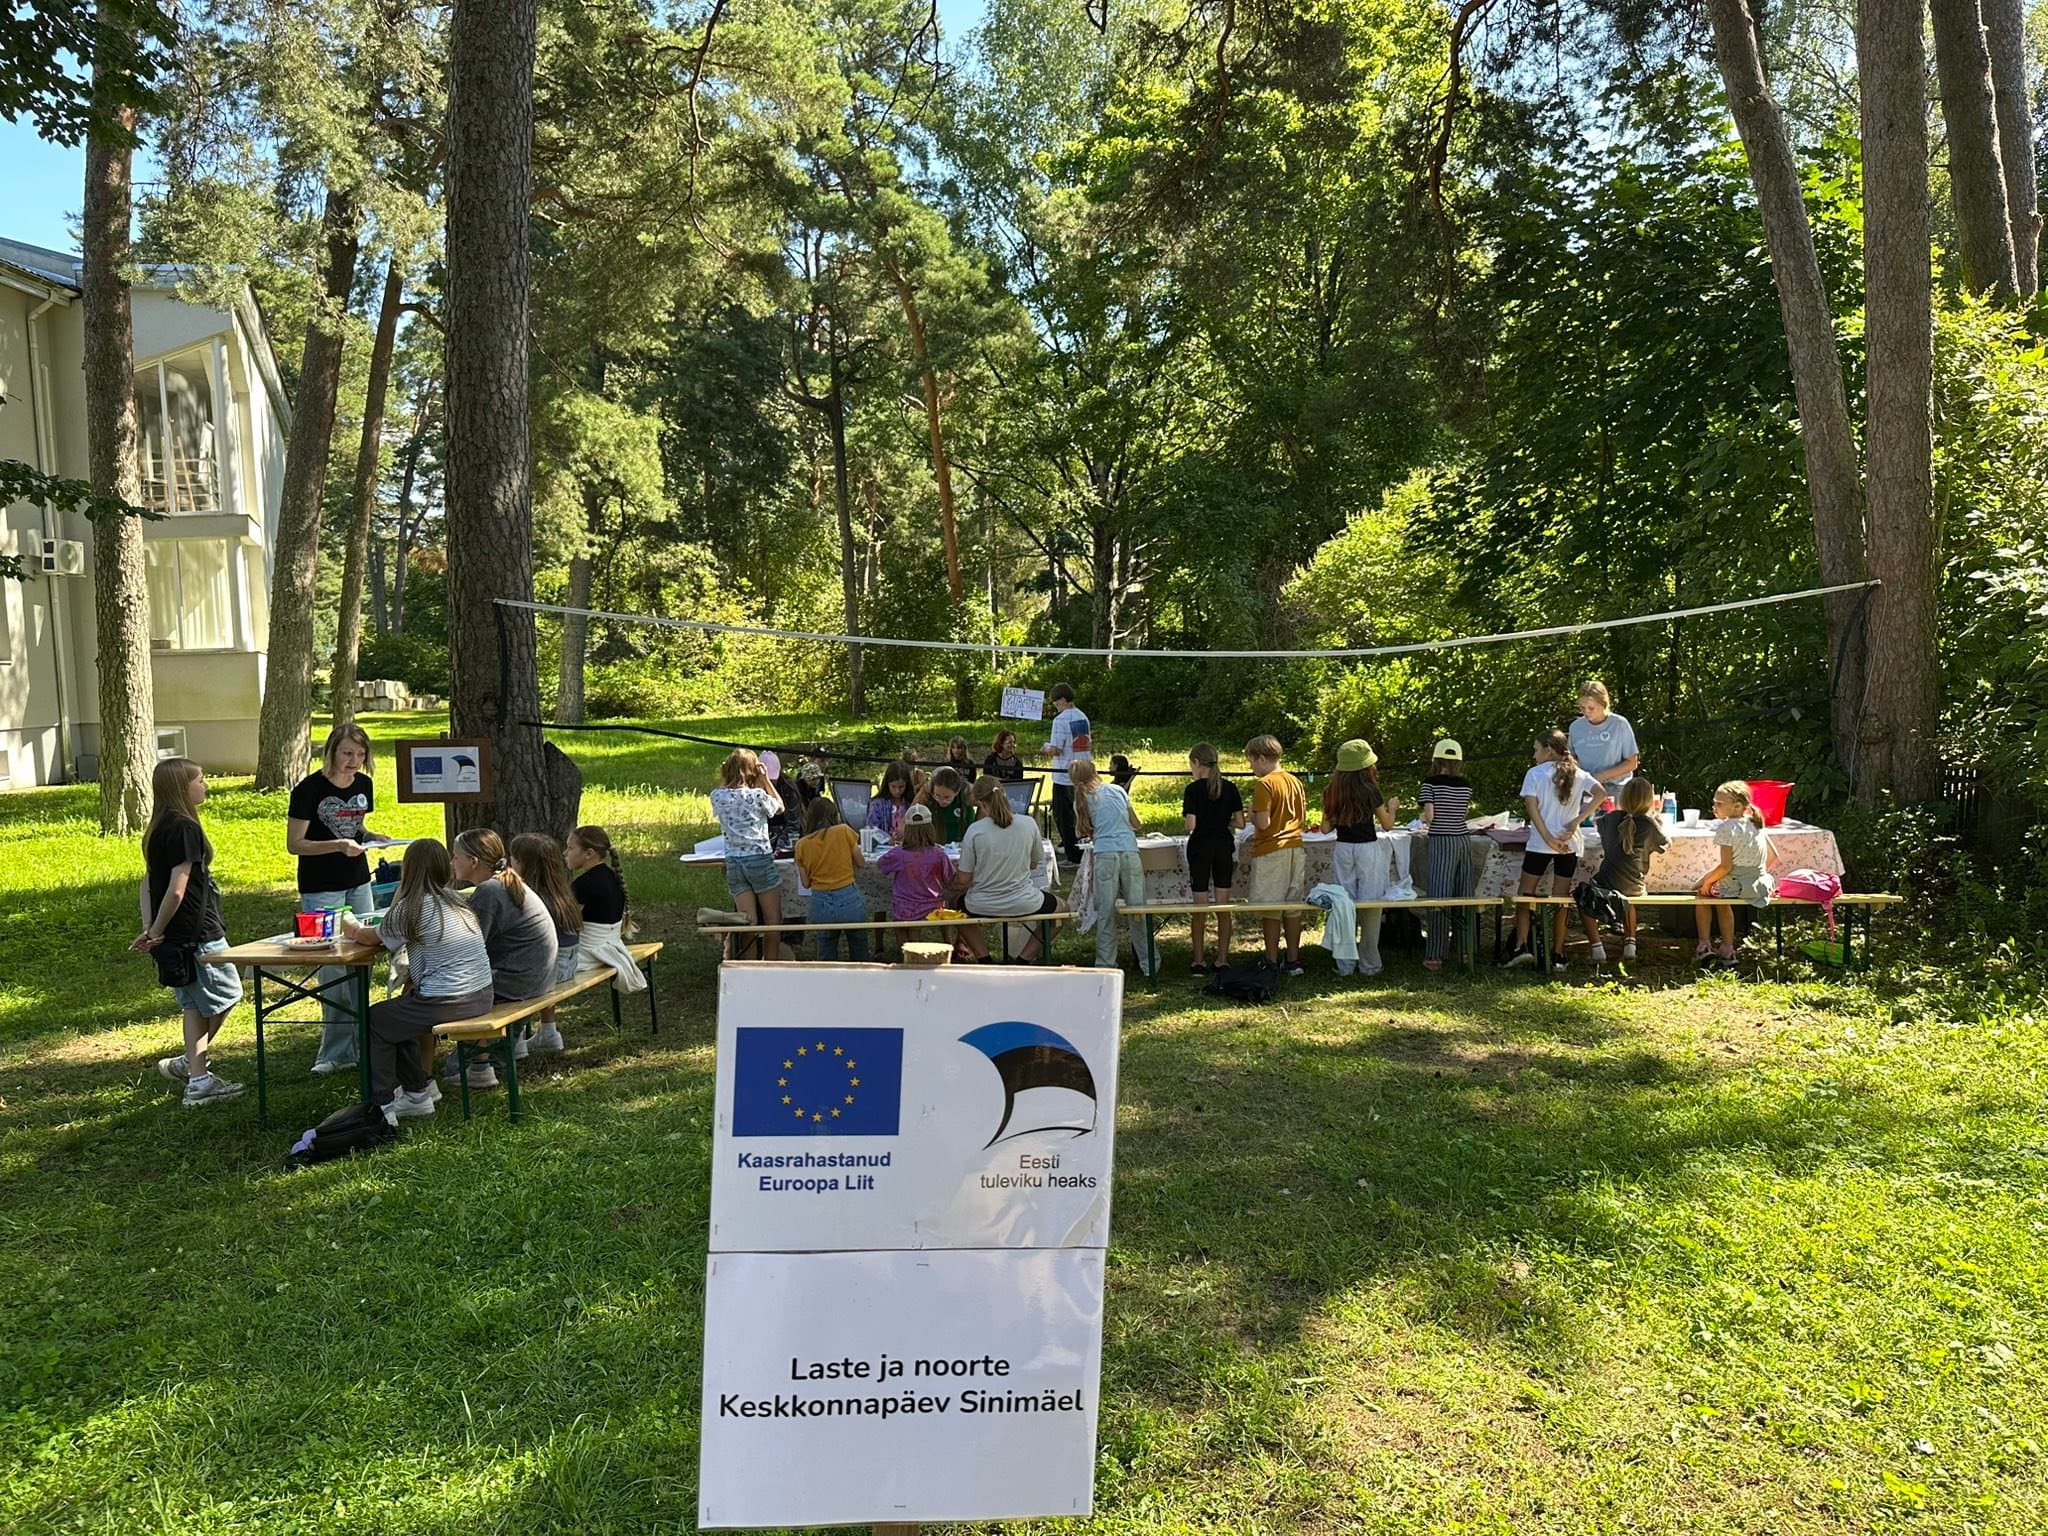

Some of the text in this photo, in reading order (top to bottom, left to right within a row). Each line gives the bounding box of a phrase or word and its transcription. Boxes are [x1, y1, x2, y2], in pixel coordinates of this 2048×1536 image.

[737, 1151, 892, 1170] Kaasrahastanud
[1019, 1153, 1061, 1170] Eesti
[758, 1173, 876, 1195] Euroopa Liit
[979, 1172, 1098, 1189] tuleviku heaks
[791, 1353, 1011, 1384] Laste ja noorte
[719, 1388, 1084, 1420] Keskkonnapäev Sinimäel
